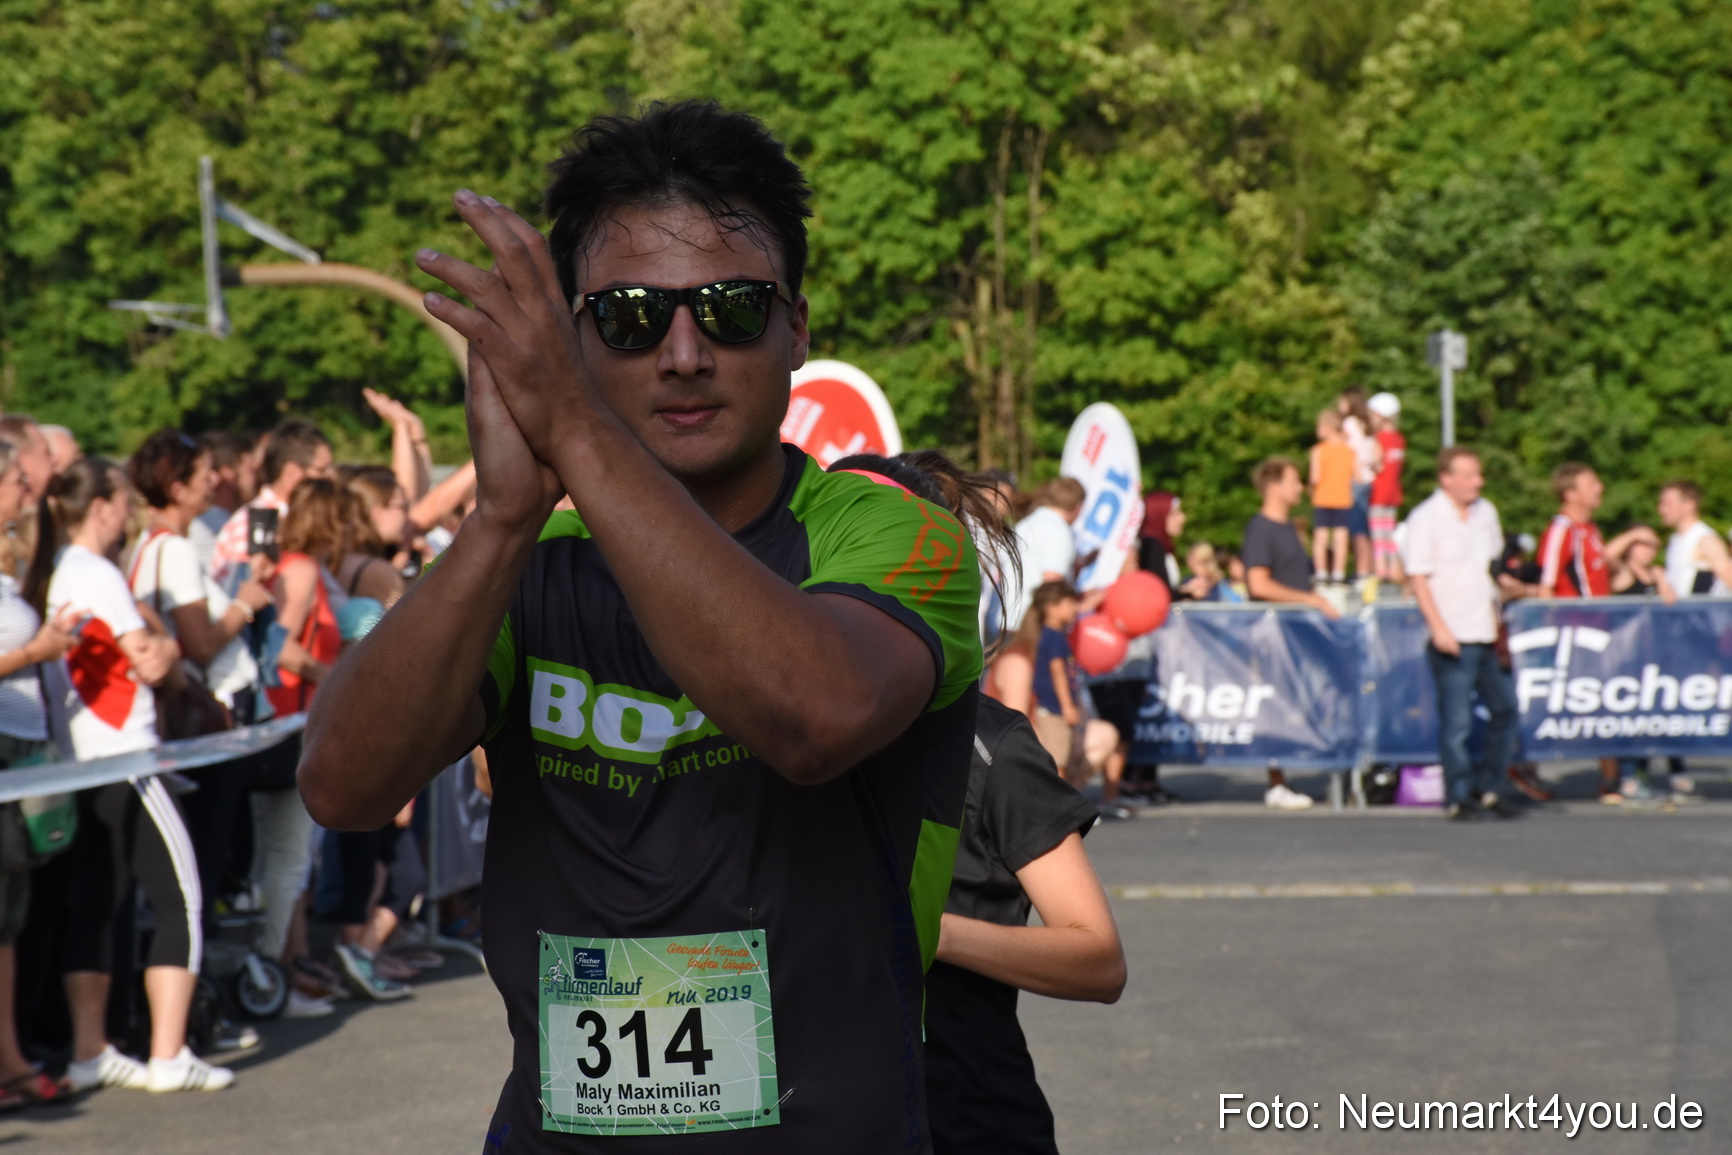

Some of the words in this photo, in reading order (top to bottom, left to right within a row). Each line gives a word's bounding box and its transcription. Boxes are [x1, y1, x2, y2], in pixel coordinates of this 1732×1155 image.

[1534, 713, 1732, 740] AUTOMOBILE
[608, 766, 642, 798] by
[666, 942, 712, 955] Gesunde
[714, 945, 750, 957] Firmen
[578, 957, 601, 965] Fischer
[687, 956, 720, 970] laufen
[563, 974, 644, 994] firmenlauf
[667, 989, 698, 1006] run
[705, 985, 752, 1003] 2019
[575, 1007, 713, 1079] 314
[576, 1082, 612, 1104] Maly
[618, 1081, 721, 1100] Maximilian
[577, 1103, 604, 1116] Bock
[607, 1104, 613, 1116] 1
[617, 1103, 656, 1116] GmbH
[660, 1103, 670, 1115] &
[673, 1103, 696, 1114] Co.
[699, 1100, 721, 1113] KG
